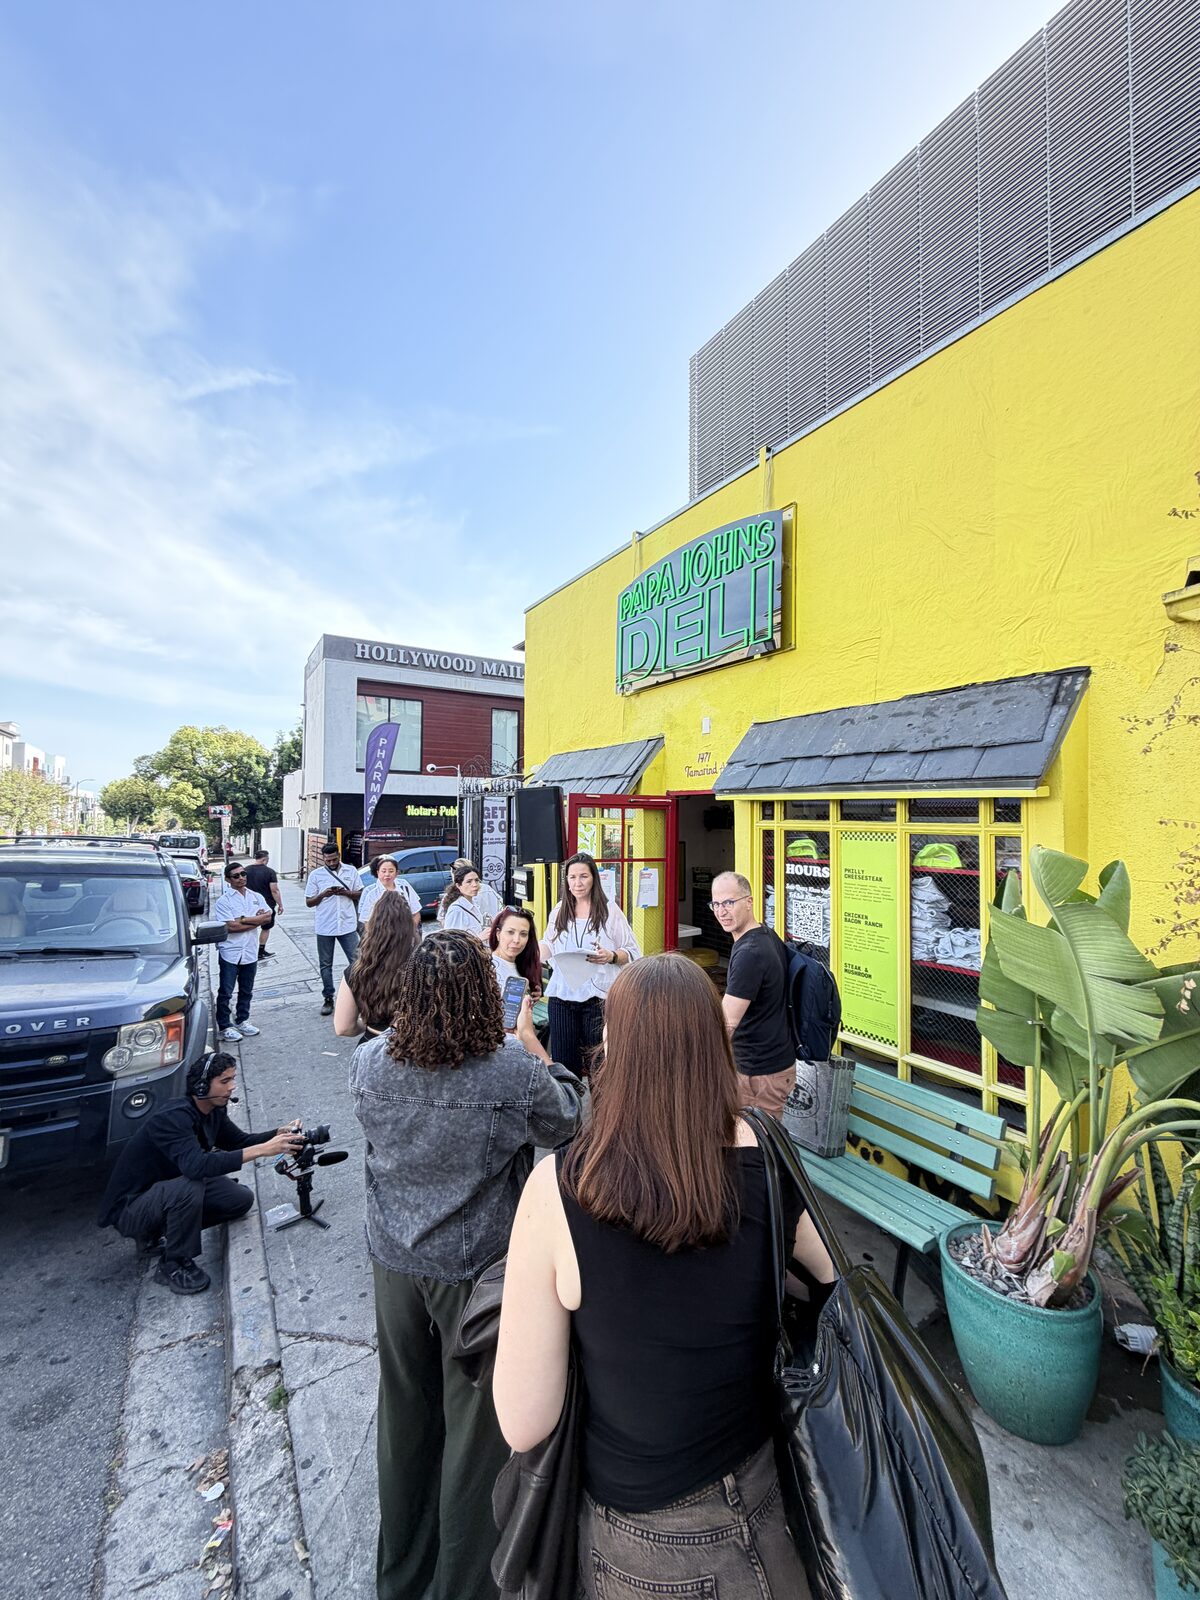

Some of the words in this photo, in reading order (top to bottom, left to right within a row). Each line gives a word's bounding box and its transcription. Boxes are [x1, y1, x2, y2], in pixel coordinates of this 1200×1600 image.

[618, 559, 776, 686] DELI
[354, 642, 476, 673] HOLLYWOOD
[684, 760, 718, 778] Tamarind
[367, 738, 387, 821] PHARMAC
[405, 804, 438, 817] Notary
[483, 806, 507, 819] GET
[785, 863, 830, 878] HOURS
[844, 873, 883, 883] CHEESESTEAK
[844, 911, 869, 920] CHICKEN
[844, 917, 862, 925] BACON
[864, 920, 883, 928] RANCH
[844, 962, 862, 971] STEAK
[844, 968, 873, 980] MUSHROOM
[5, 1017, 91, 1034] OVER
